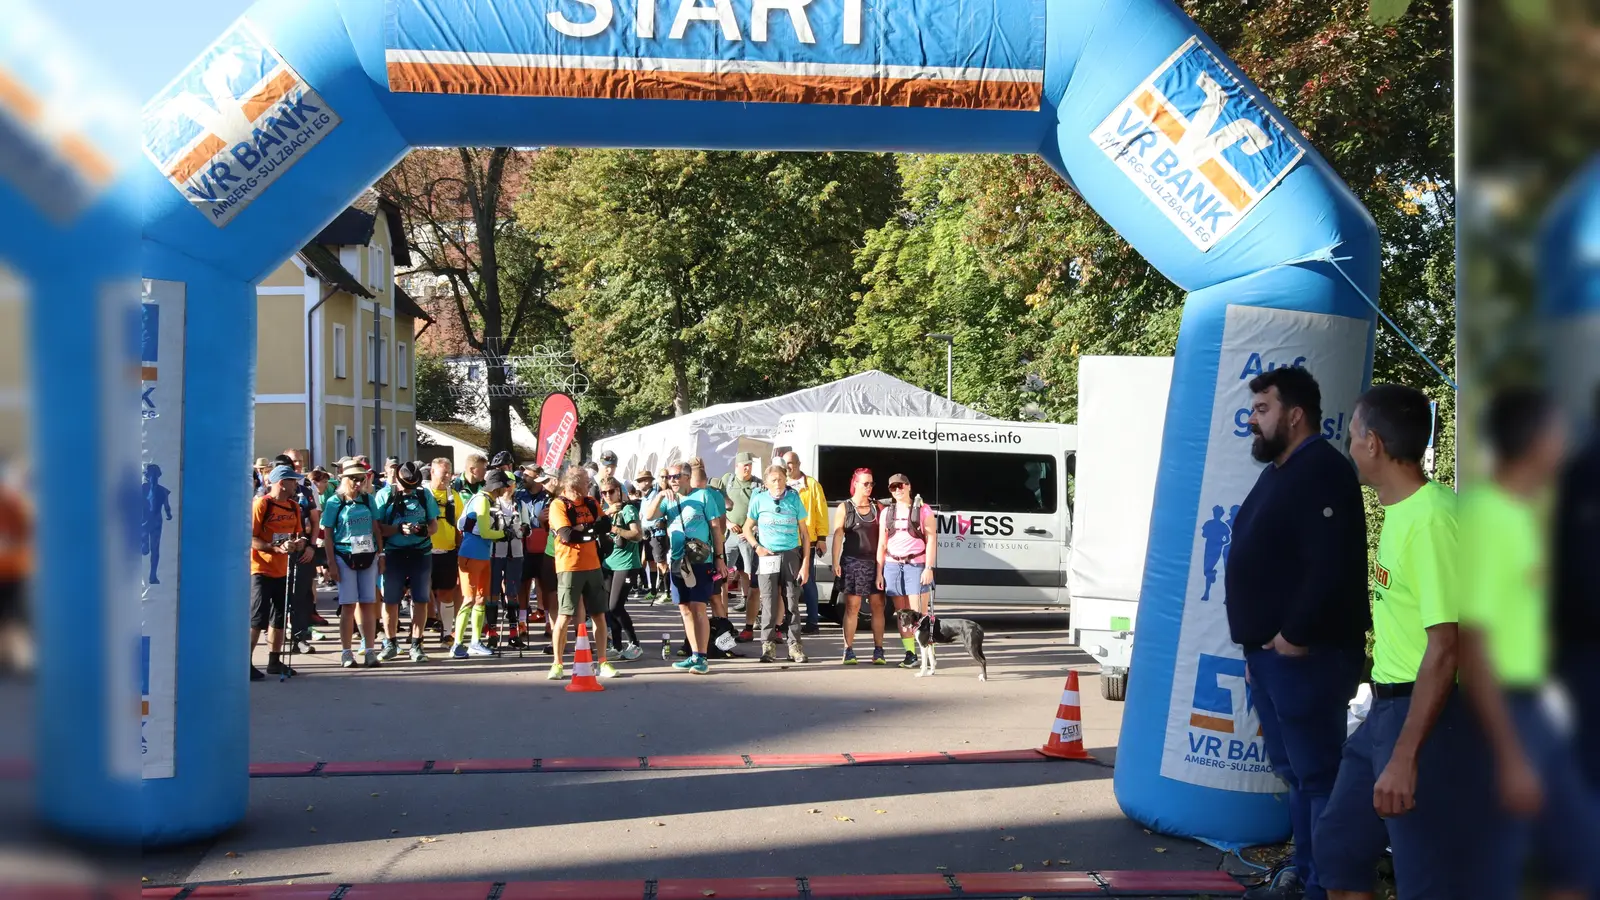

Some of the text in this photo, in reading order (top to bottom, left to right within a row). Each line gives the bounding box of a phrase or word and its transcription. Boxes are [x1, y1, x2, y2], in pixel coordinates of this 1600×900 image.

[187, 89, 321, 204] VR BANK
[211, 112, 331, 219] AMBERG-SULZBACH EG
[1116, 107, 1234, 234] VR BANK
[1194, 225, 1212, 243] EG
[859, 427, 1022, 444] www.zeitgemaess.info
[935, 514, 1014, 536] MAESS
[937, 541, 1030, 550] NDER ZEITMESSUNG
[1061, 724, 1079, 736] ZEIT
[1188, 731, 1222, 758] VR
[1184, 753, 1275, 773] AMBERG-SULZBAC
